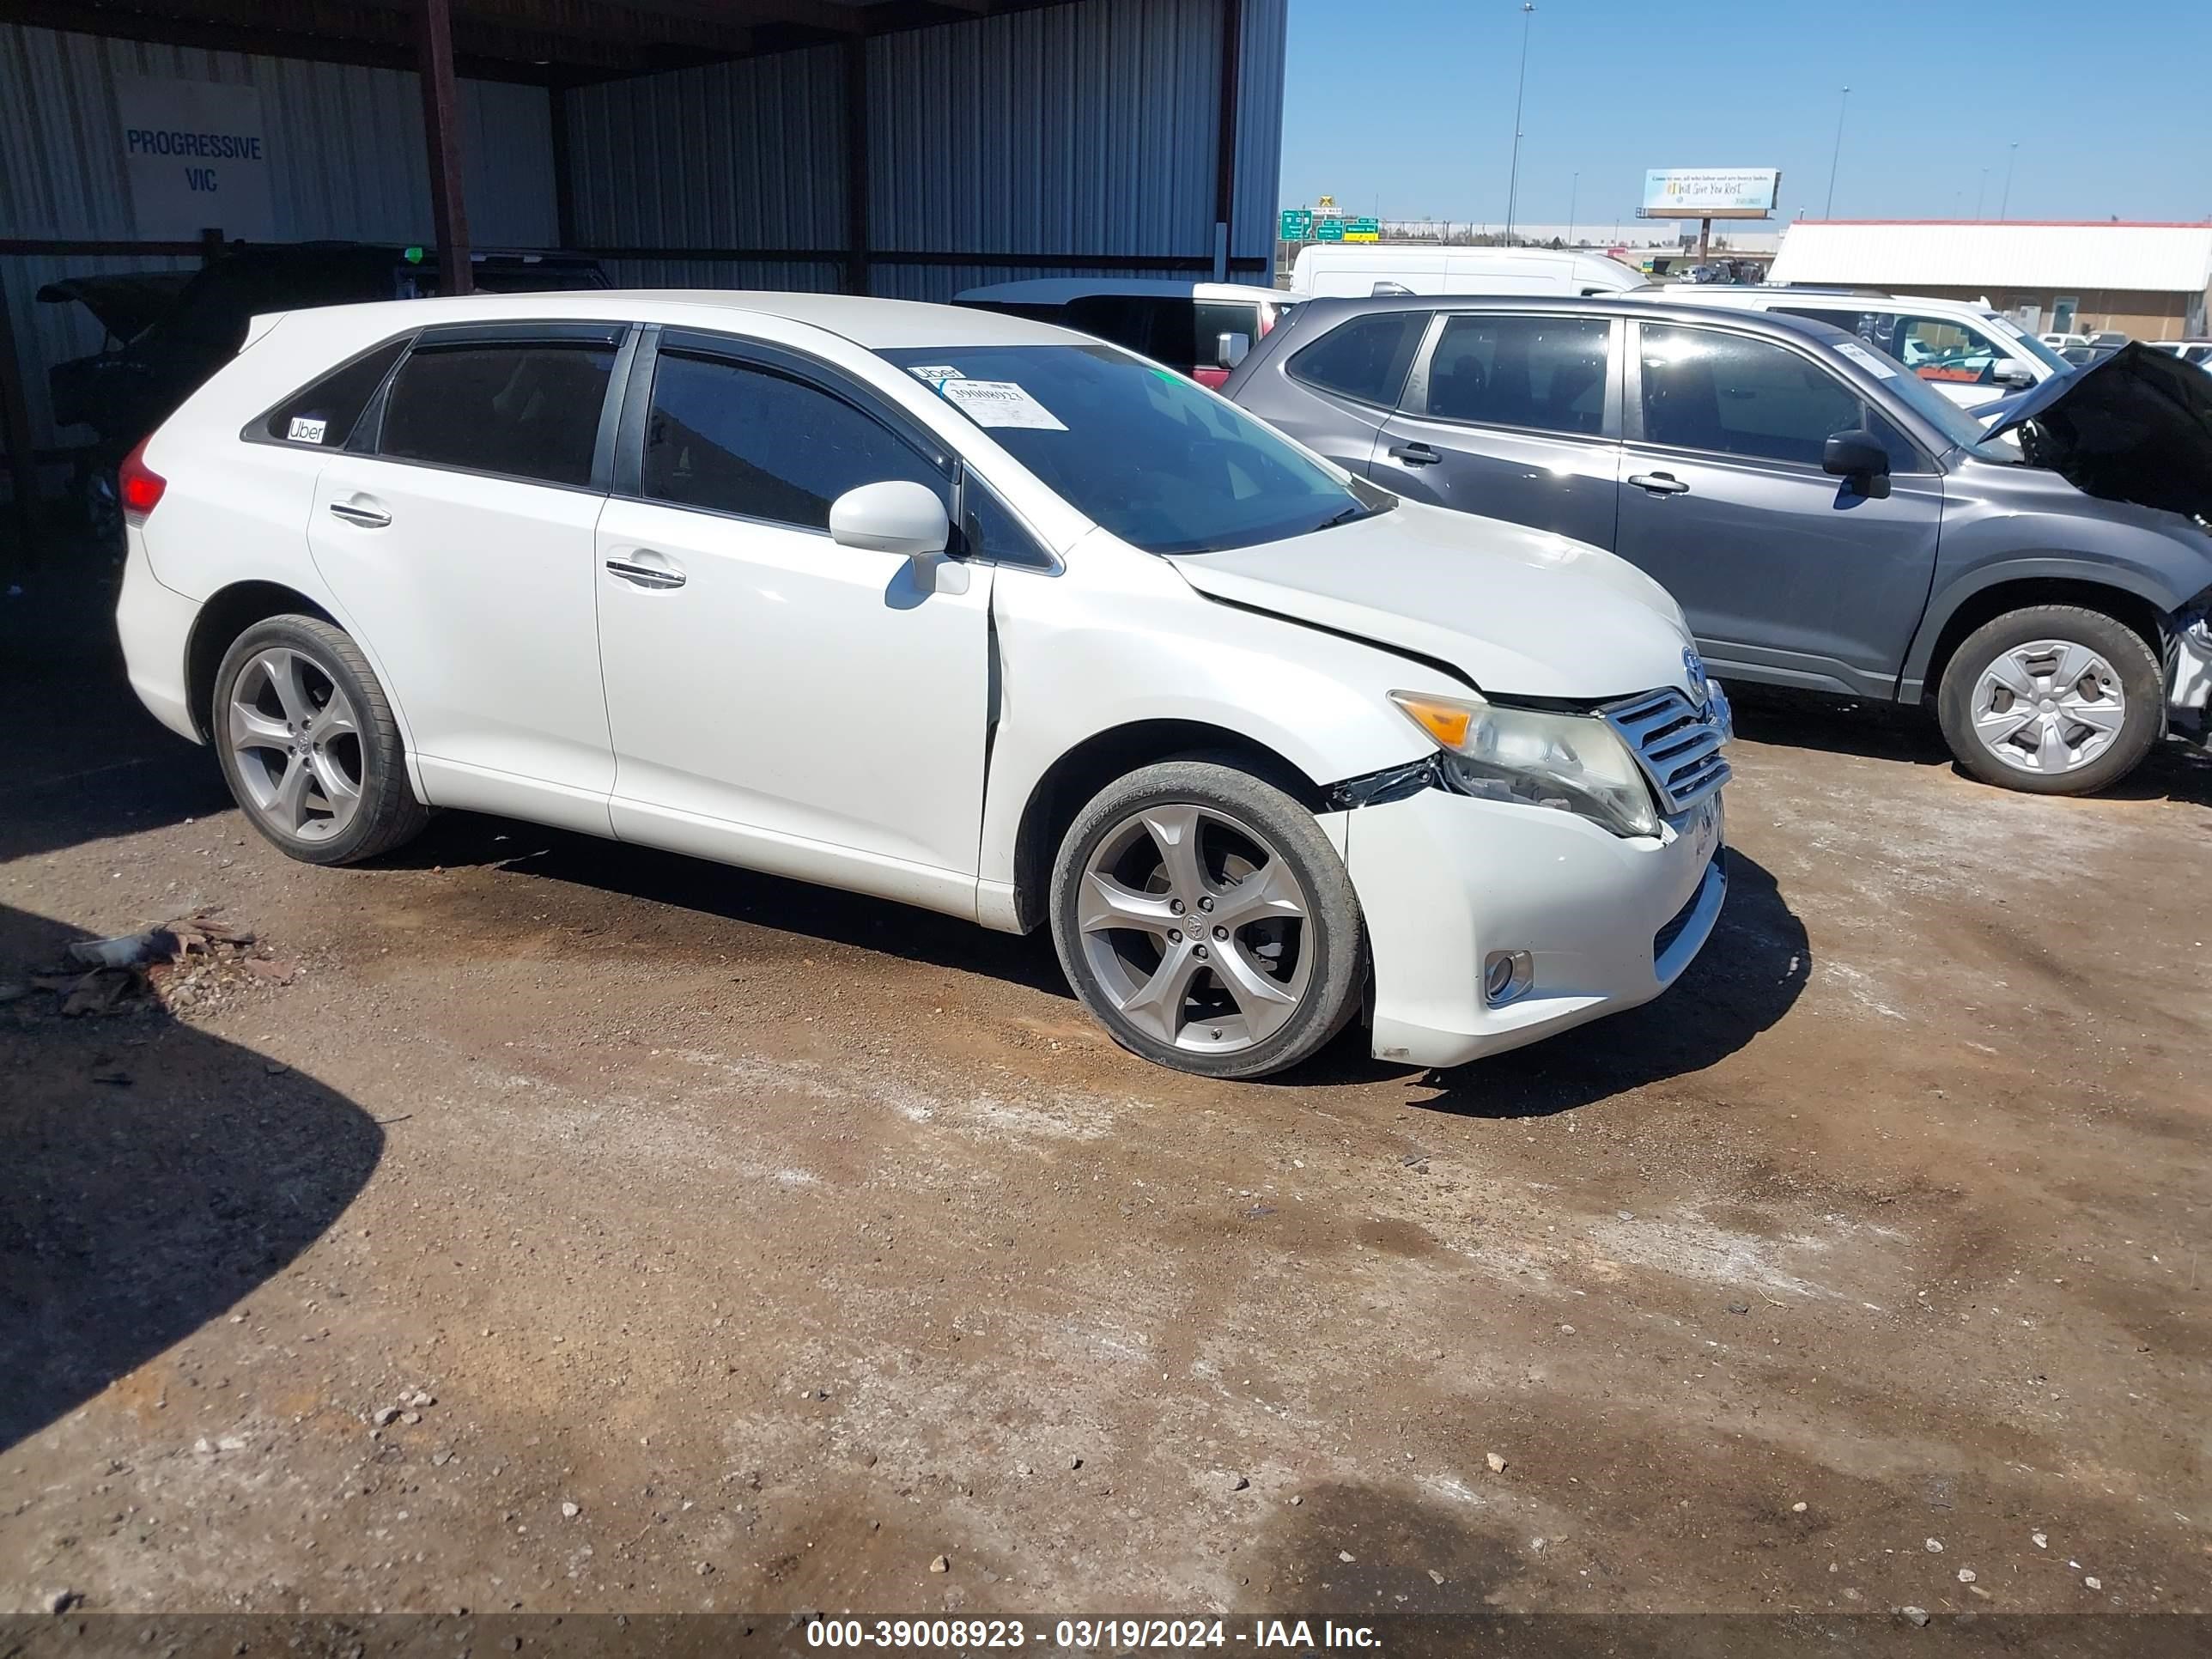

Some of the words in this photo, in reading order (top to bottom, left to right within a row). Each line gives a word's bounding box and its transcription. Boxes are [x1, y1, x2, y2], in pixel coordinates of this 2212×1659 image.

[127, 129, 262, 161] PROGRESSIVE
[185, 167, 218, 192] VIC
[910, 368, 961, 378] Uber
[951, 389, 1024, 401] 39008923
[290, 420, 324, 440] Uber
